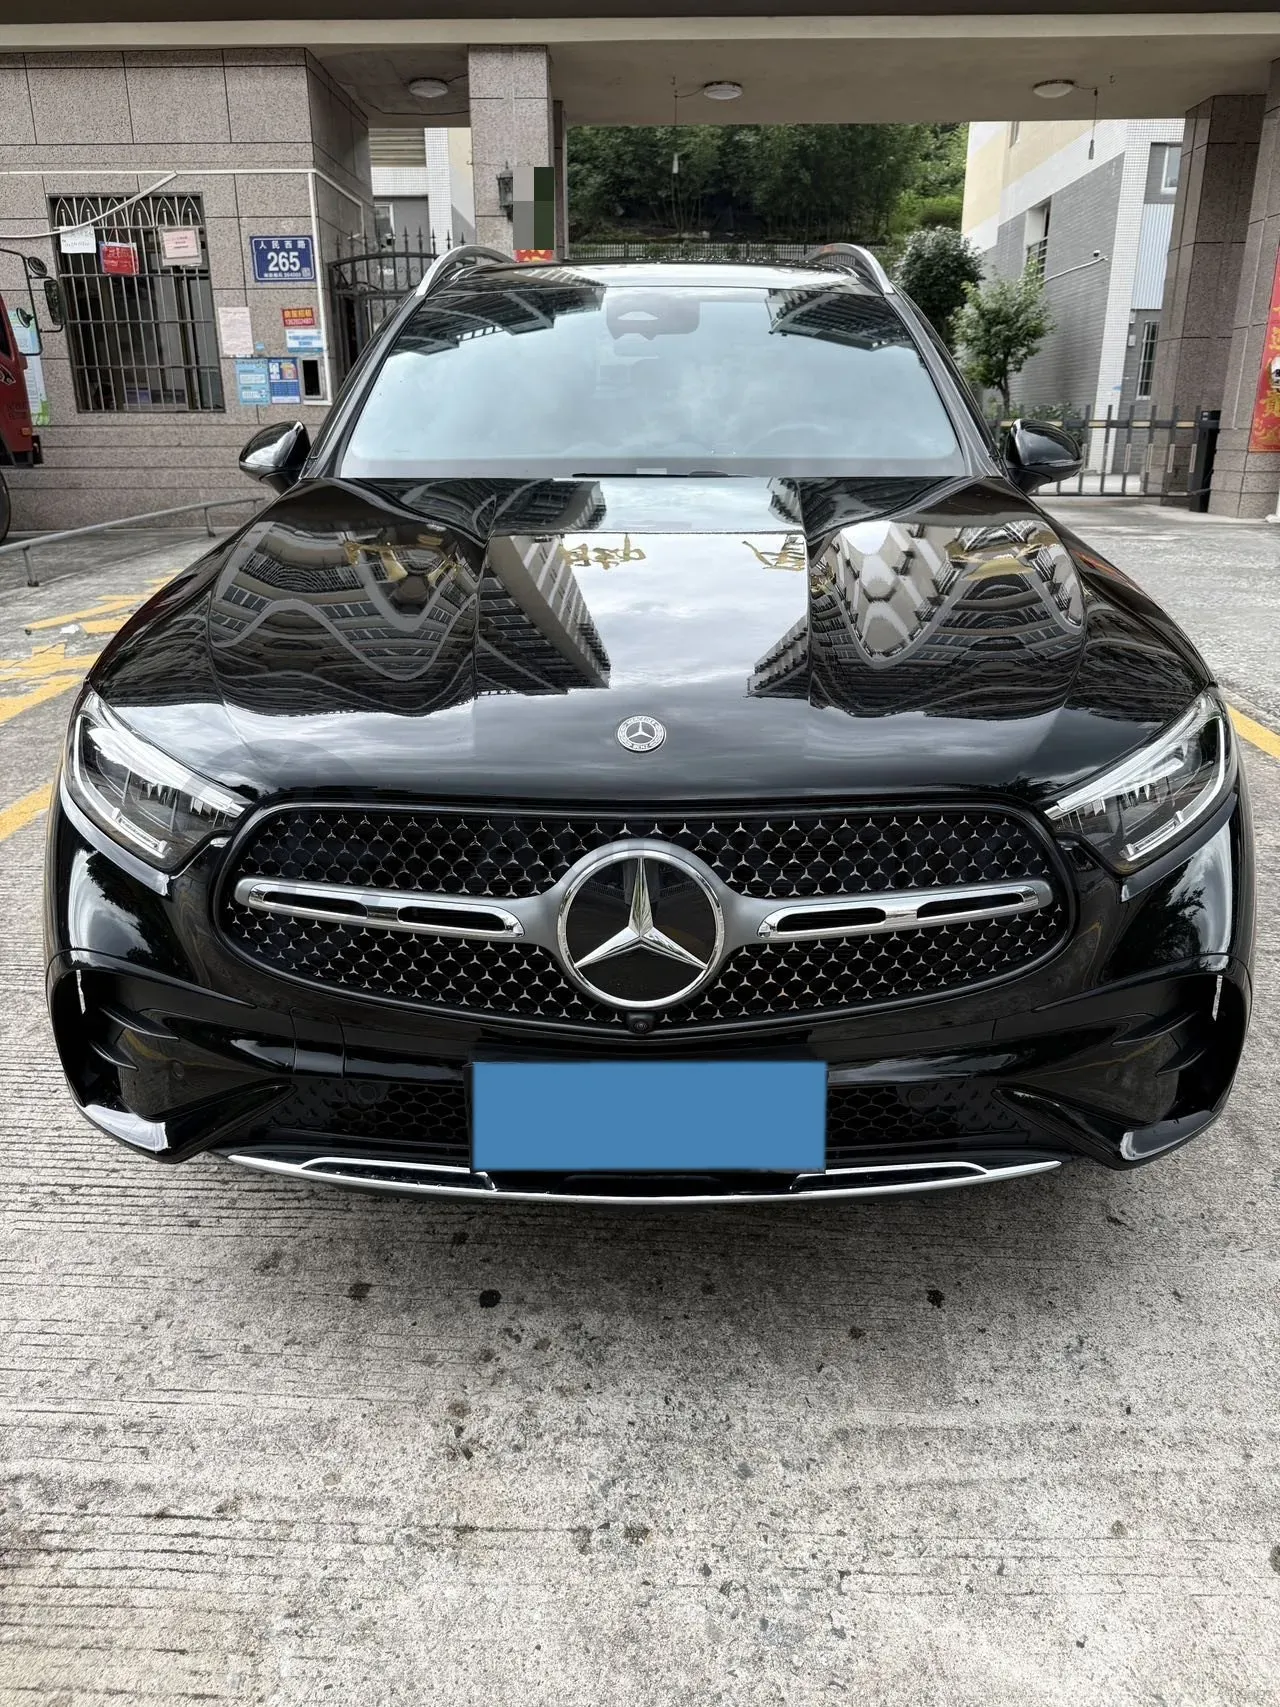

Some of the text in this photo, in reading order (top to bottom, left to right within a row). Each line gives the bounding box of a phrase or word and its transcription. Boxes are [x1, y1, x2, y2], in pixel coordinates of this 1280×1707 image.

[259, 240, 306, 249] 人民西路
[267, 251, 301, 272] 265
